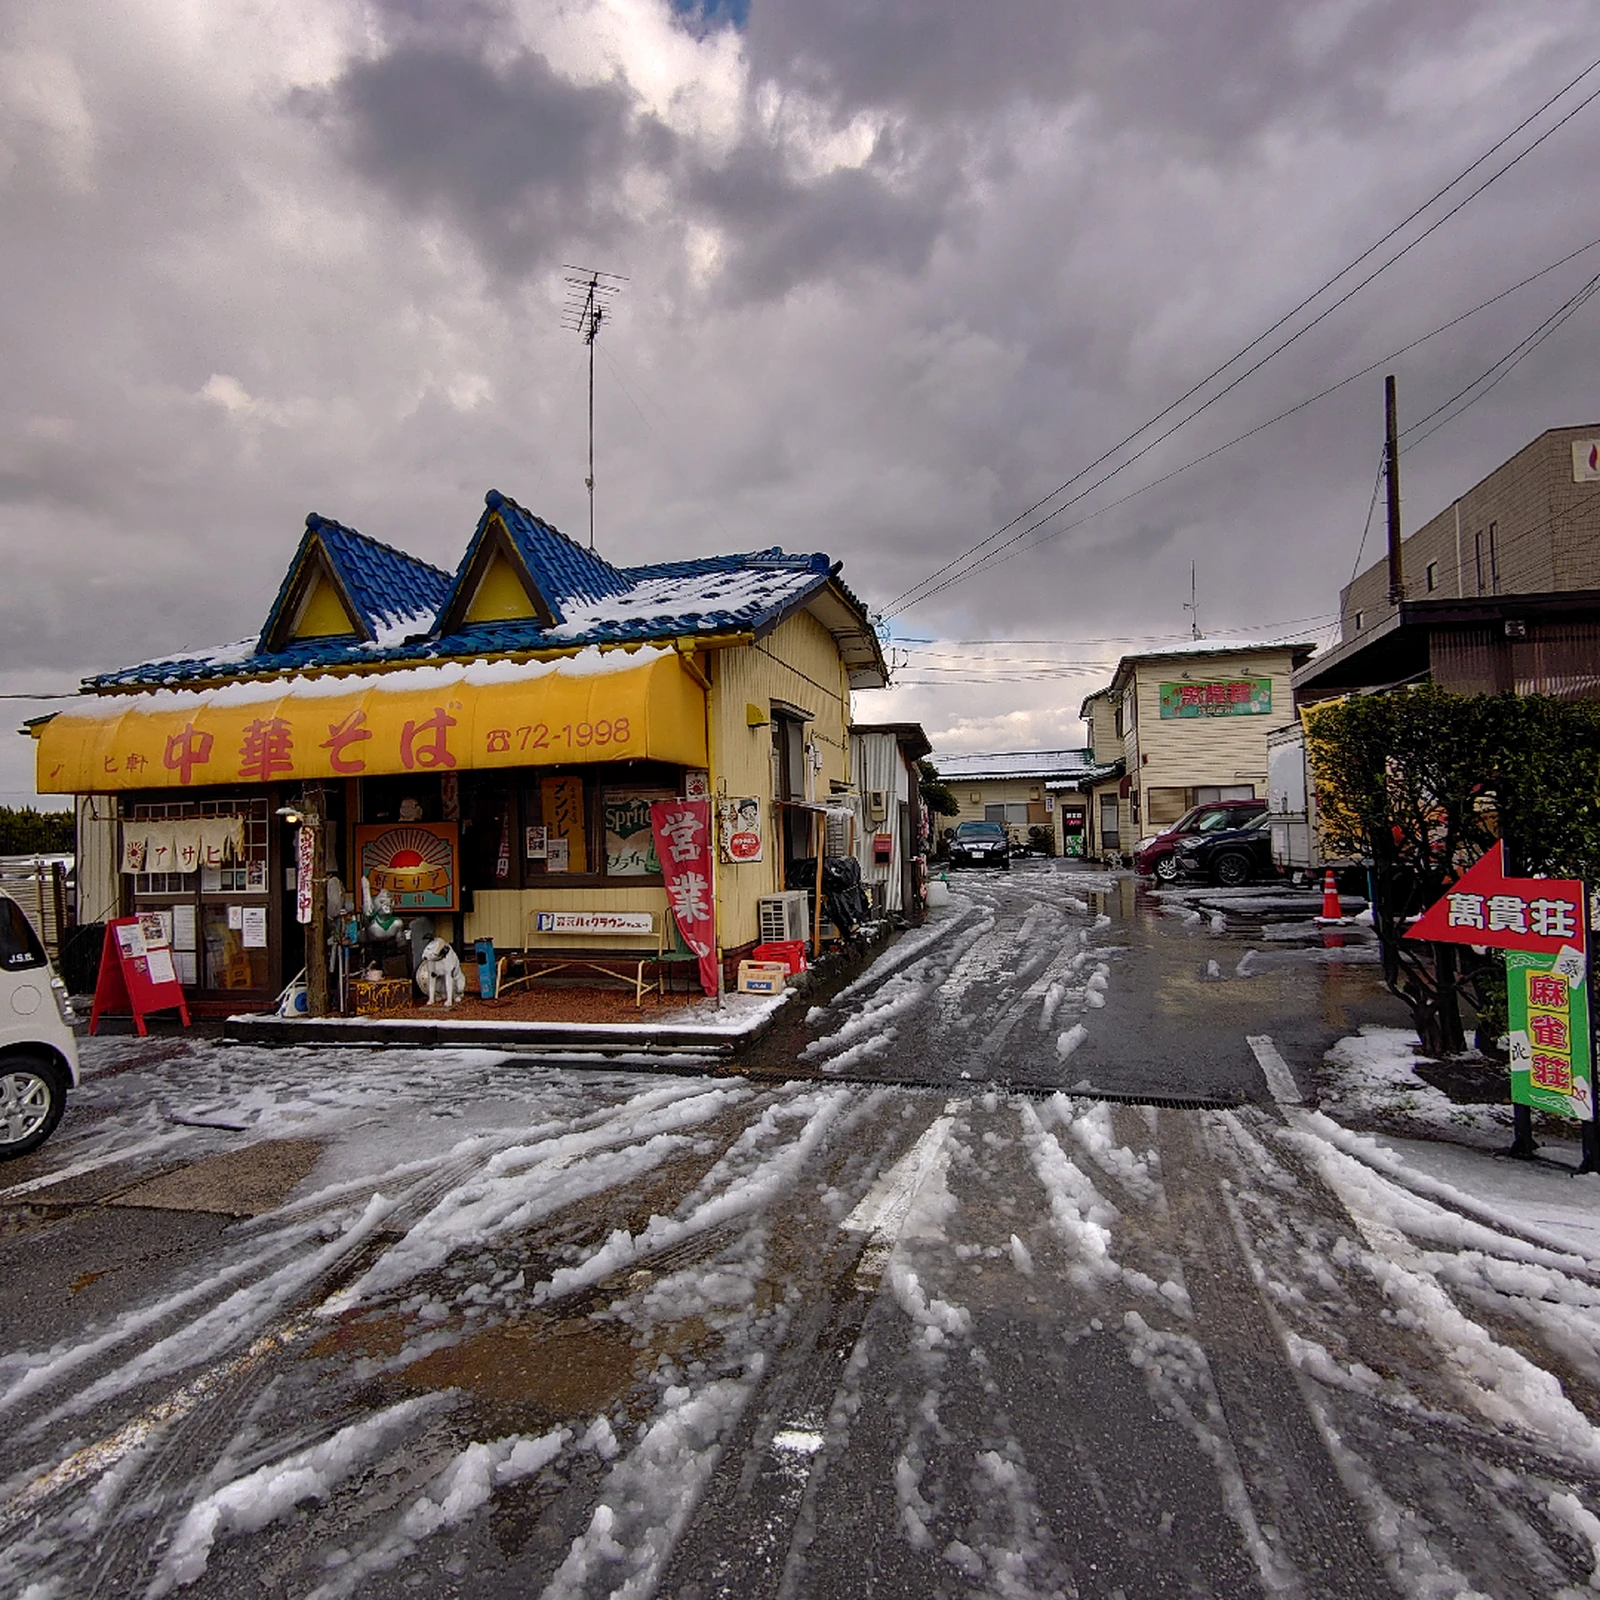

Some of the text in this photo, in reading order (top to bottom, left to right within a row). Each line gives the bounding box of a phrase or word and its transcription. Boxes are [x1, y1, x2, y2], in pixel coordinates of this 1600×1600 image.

[163, 700, 463, 785] 中華そば
[515, 717, 631, 751] 72-1998
[155, 845, 221, 866] アサヒ
[1446, 893, 1576, 938] 萬貫荘
[1529, 974, 1572, 1089] 麻雀荘
